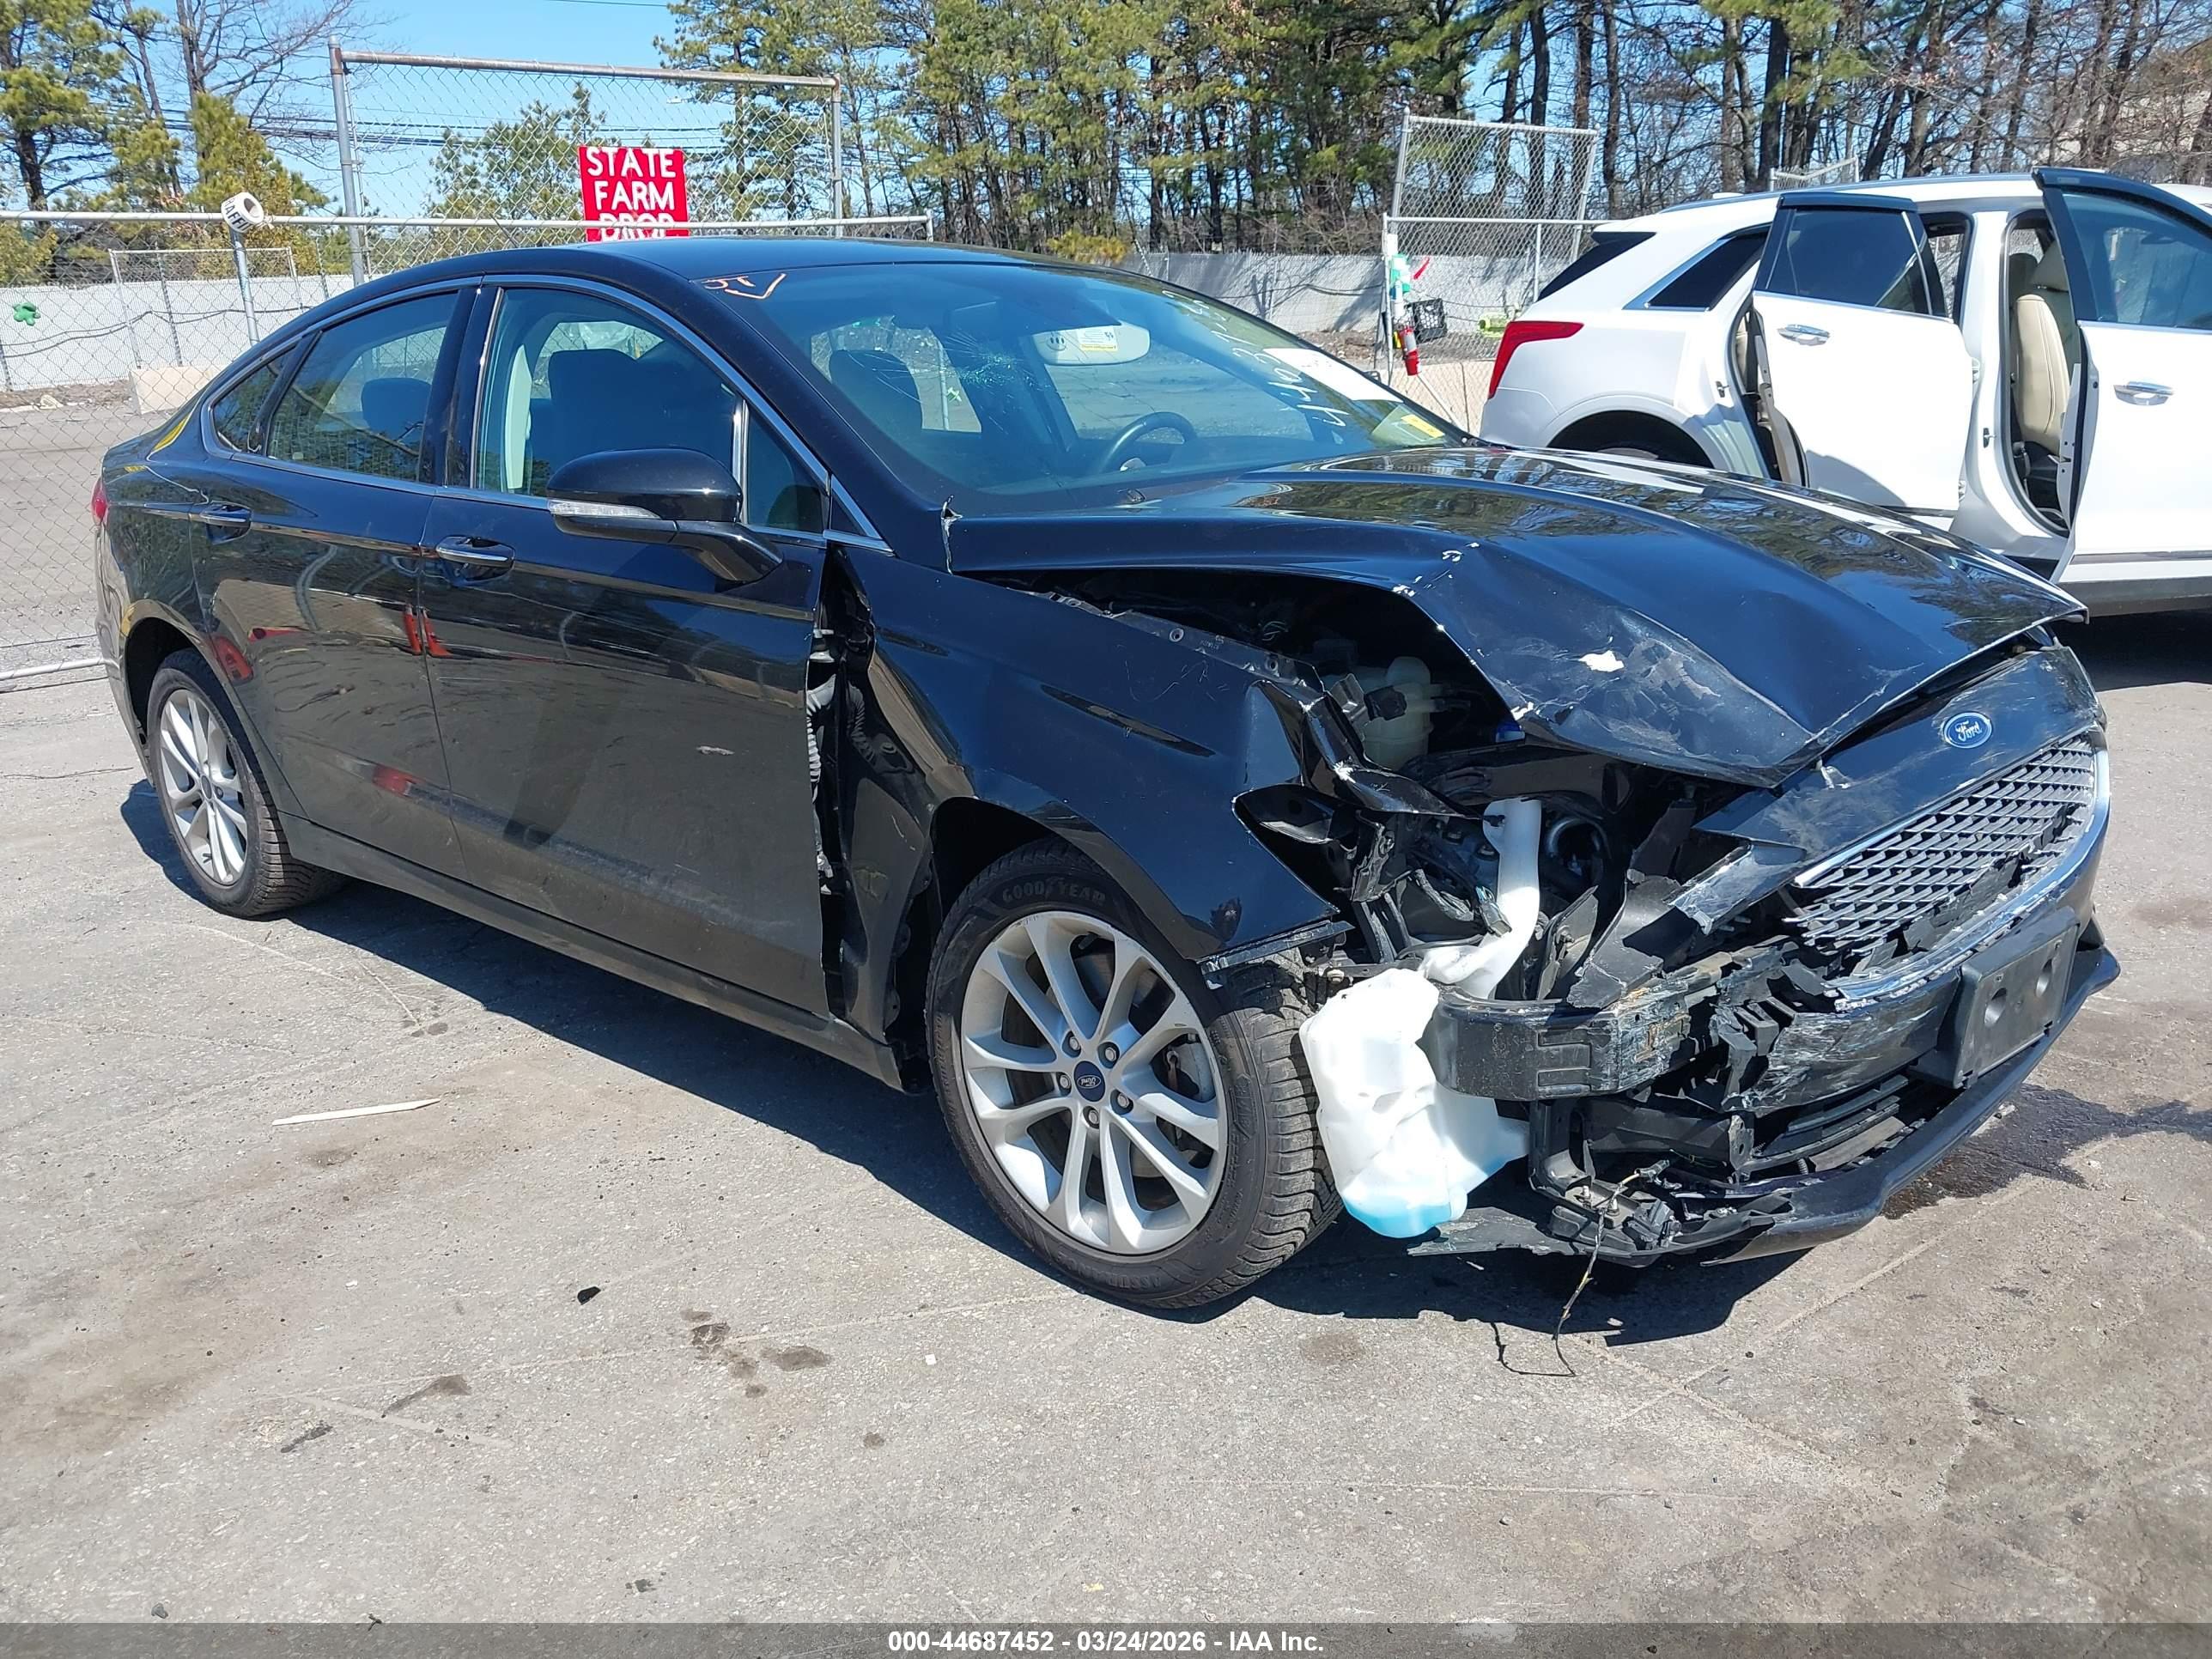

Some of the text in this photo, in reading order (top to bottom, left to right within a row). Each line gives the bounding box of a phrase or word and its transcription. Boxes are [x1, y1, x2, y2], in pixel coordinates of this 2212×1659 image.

[586, 146, 677, 178] STATE
[593, 180, 675, 210] FARM
[224, 198, 256, 232] RAFFI
[1954, 718, 1984, 743] Ford
